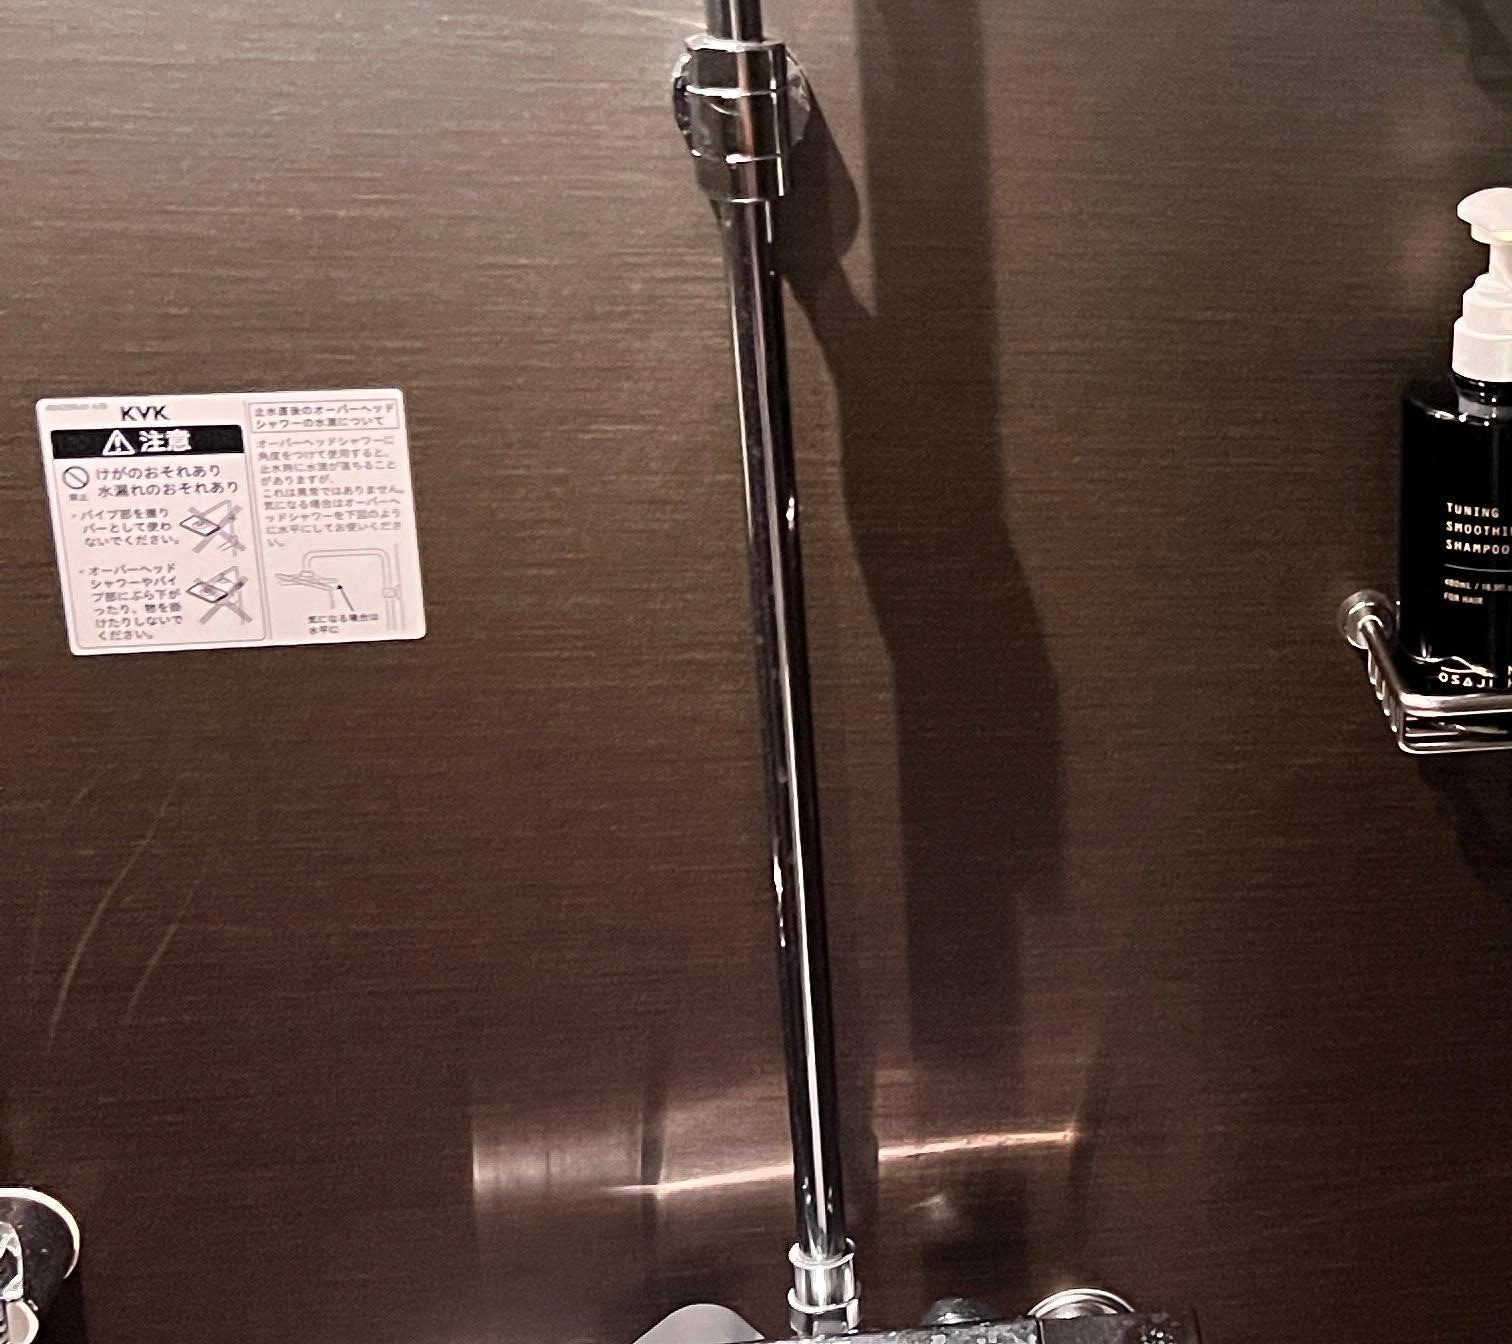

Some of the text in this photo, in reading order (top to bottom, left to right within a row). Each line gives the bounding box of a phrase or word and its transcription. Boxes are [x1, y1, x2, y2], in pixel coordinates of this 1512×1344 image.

[120, 405, 170, 422] KVK
[138, 429, 192, 453] 注意
[96, 464, 220, 481] けがのおそれあり
[97, 481, 238, 498] 水漏れのおそれあり
[1446, 502, 1500, 518] TUNING
[1445, 539, 1510, 554] SHAMPOO
[1438, 672, 1494, 688] OSAJI
